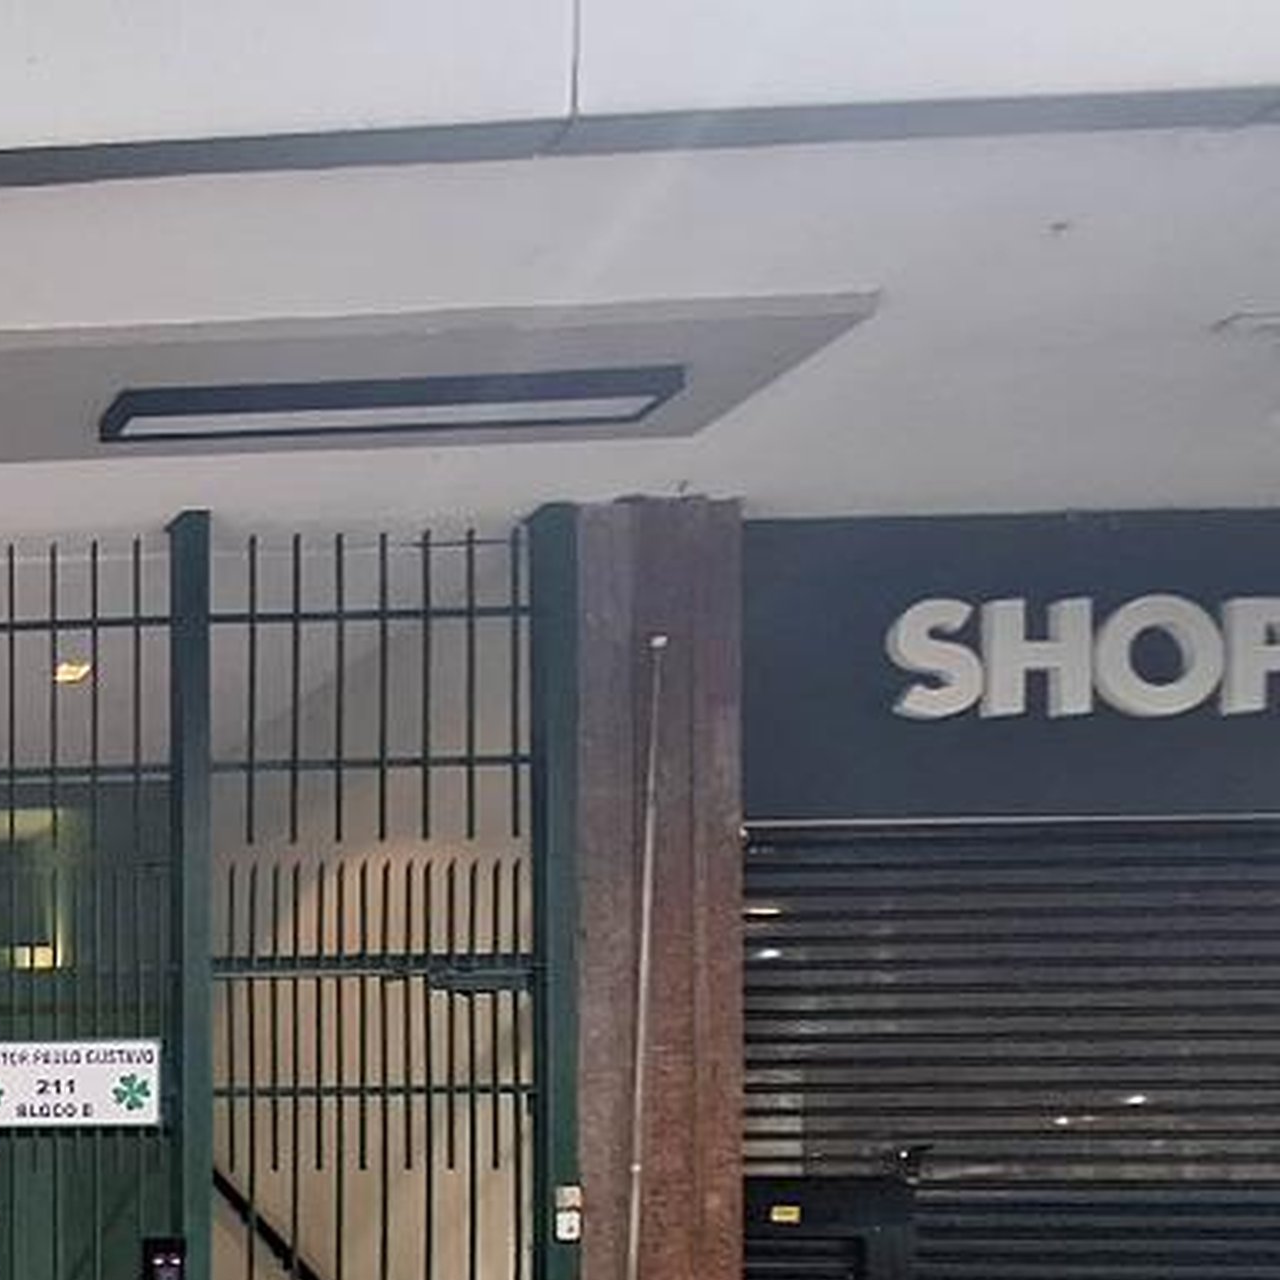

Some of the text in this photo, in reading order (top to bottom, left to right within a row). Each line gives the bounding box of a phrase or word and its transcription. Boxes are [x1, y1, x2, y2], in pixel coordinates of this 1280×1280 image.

[85, 1048, 154, 1064] GUSTAVO
[36, 1079, 75, 1094] 211
[16, 1102, 77, 1117] BLOCO
